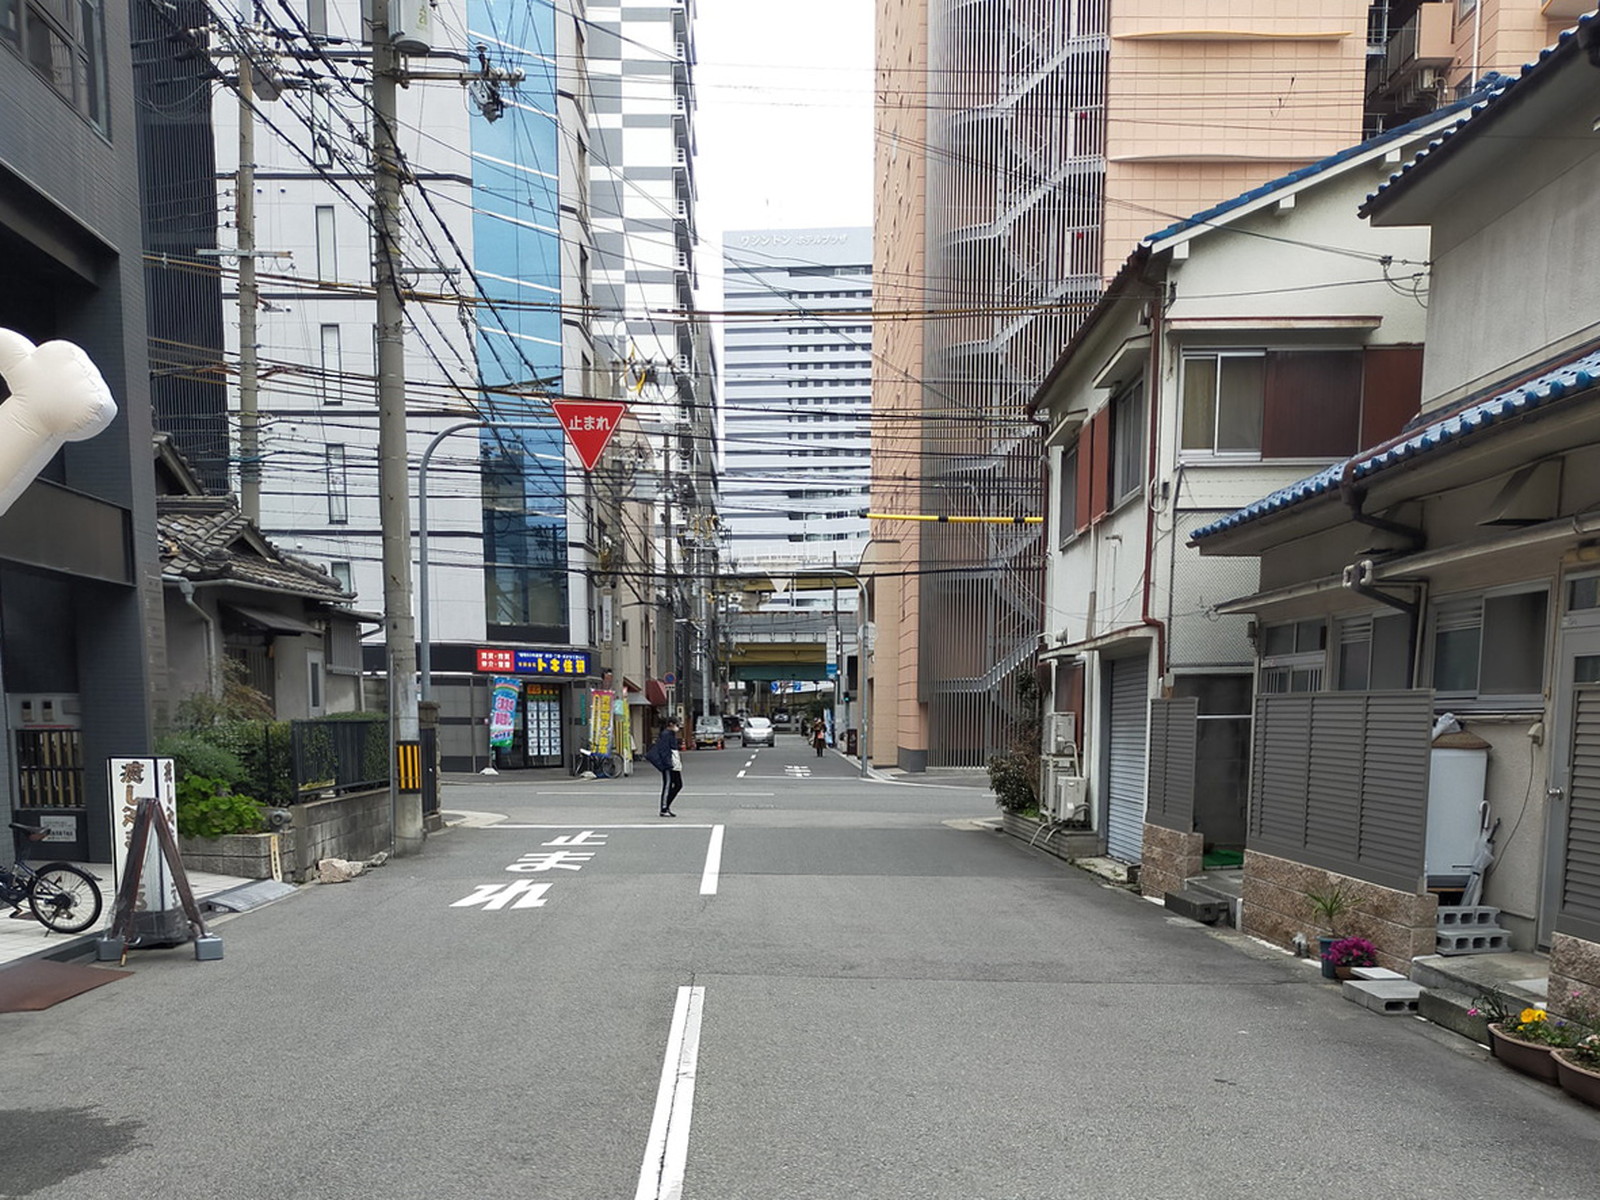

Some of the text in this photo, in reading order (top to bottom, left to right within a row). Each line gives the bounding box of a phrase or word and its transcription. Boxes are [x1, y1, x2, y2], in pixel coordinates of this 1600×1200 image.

[568, 415, 611, 431] 止まれ
[449, 831, 608, 911] 止まれ
